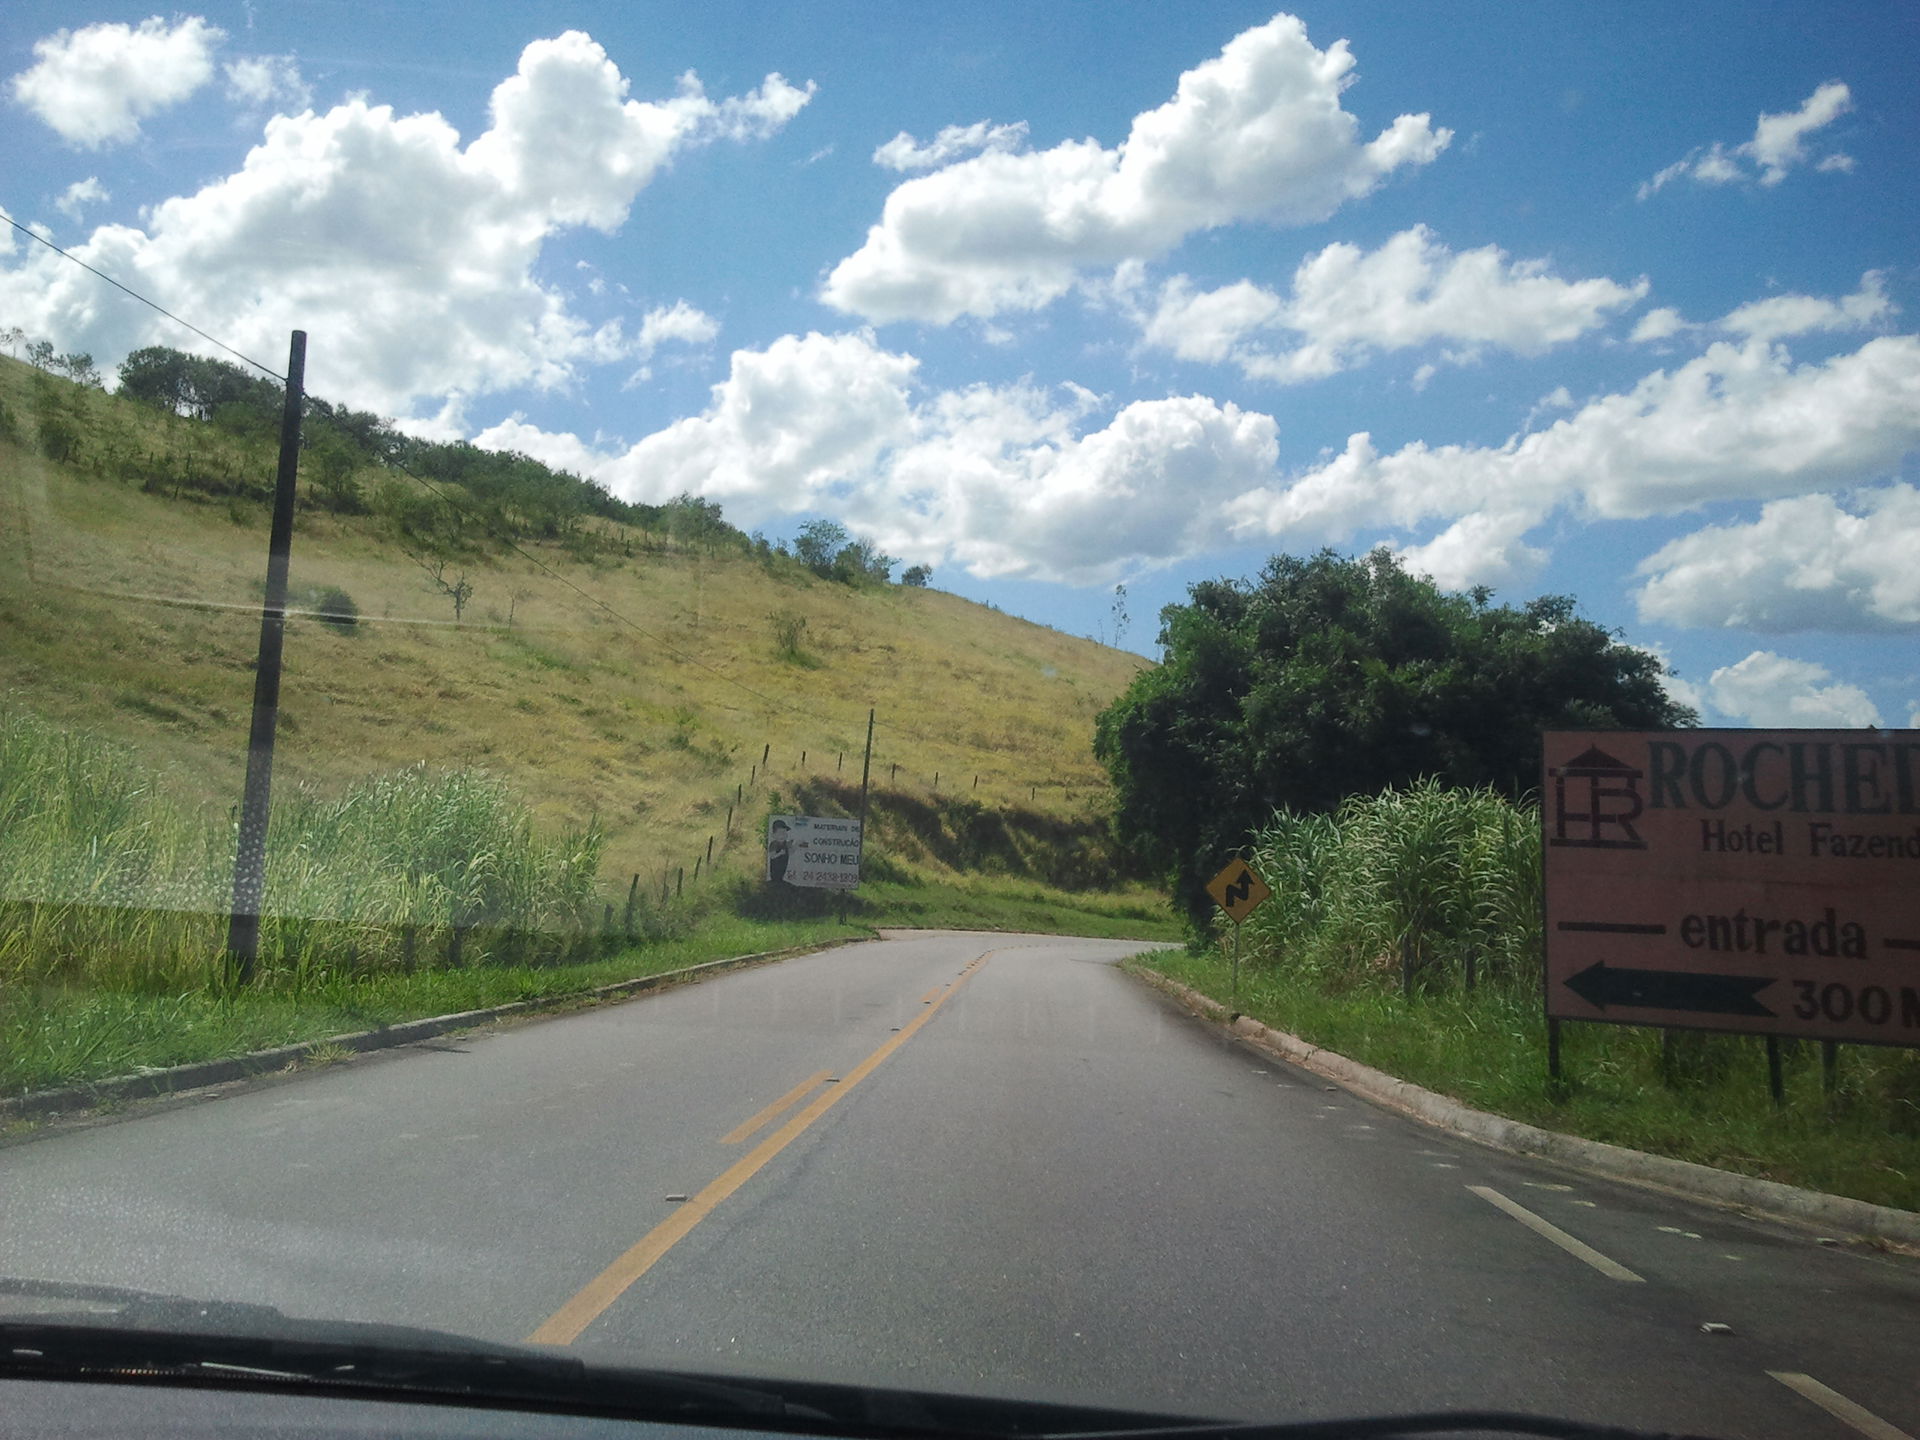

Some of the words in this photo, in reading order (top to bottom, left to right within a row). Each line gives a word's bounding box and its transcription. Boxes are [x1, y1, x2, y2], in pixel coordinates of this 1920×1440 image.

[1700, 818, 1784, 856] Hotel
[803, 852, 837, 864] SONHO
[840, 854, 859, 865] MEU
[1680, 907, 1868, 960] entrada
